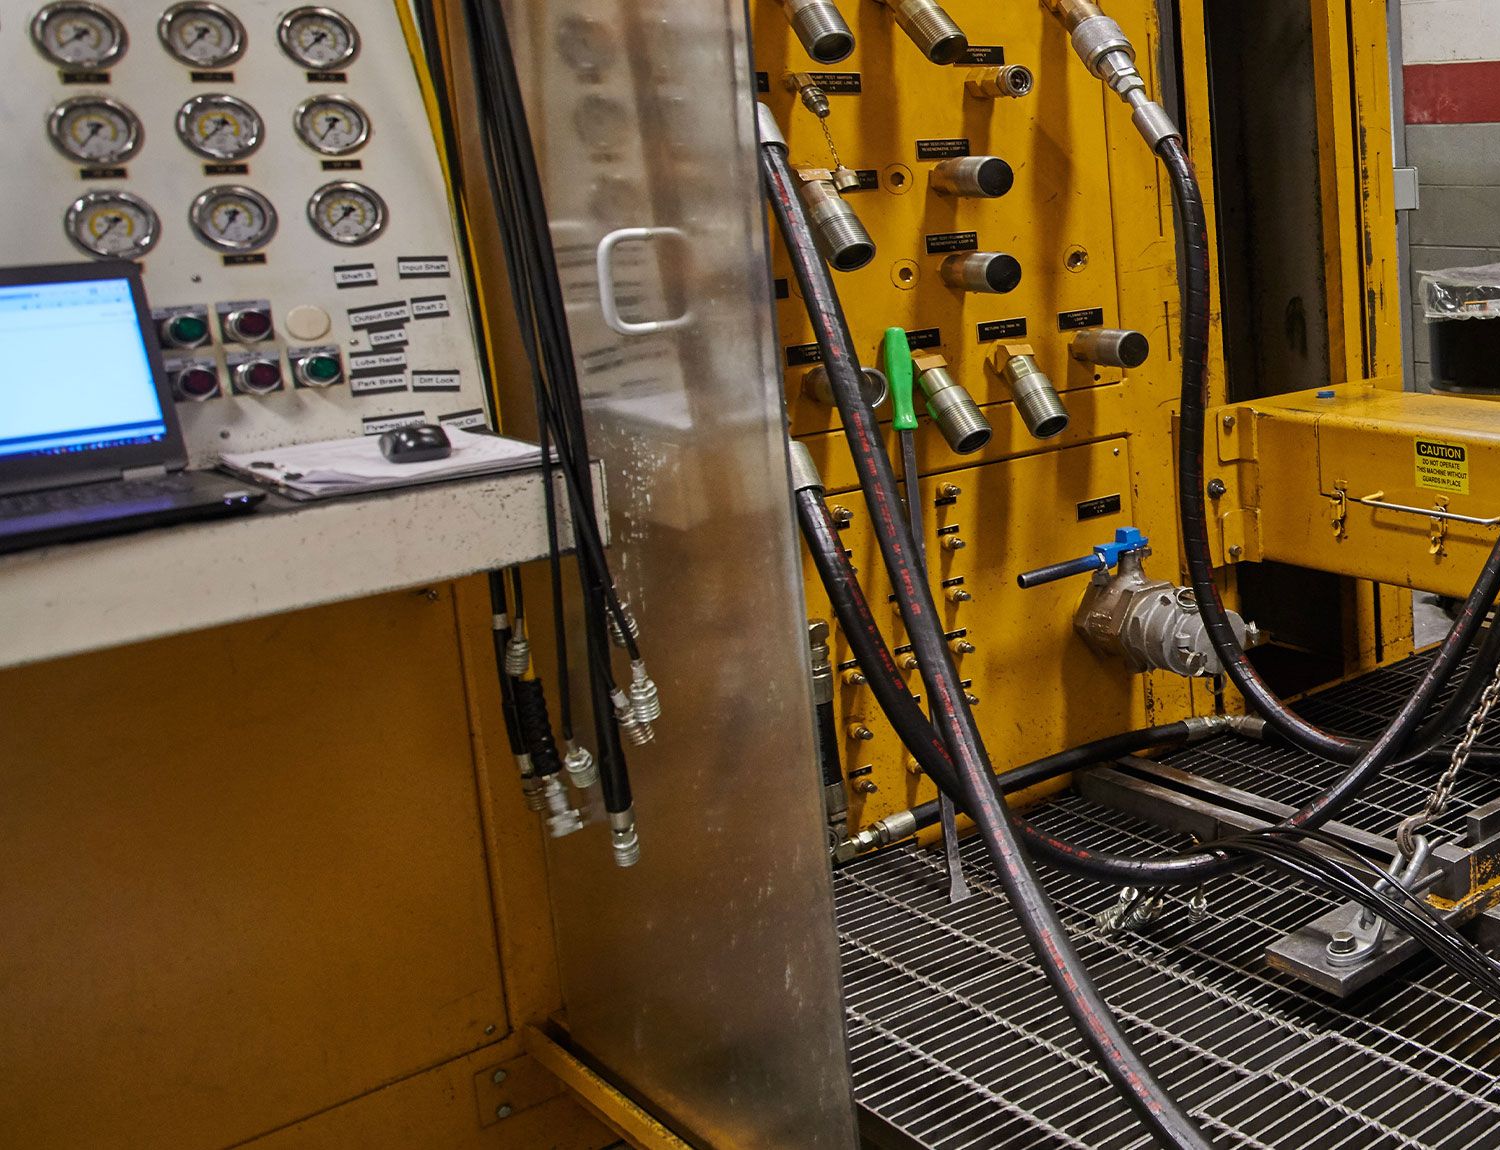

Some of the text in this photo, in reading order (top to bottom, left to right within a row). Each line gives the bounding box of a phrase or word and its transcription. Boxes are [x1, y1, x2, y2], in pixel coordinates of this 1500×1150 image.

[342, 272, 363, 280] Shaft
[416, 304, 436, 312] Shaft
[354, 309, 406, 323] Output Shaft
[374, 333, 396, 342] Shaft
[355, 356, 402, 367] Lube Relief
[1420, 444, 1461, 459] CAUTION
[1440, 461, 1460, 470] OPERATE
[1427, 467, 1446, 476] MACHINE
[1446, 471, 1467, 479] WITHOUT
[1447, 479, 1461, 487] PLACE
